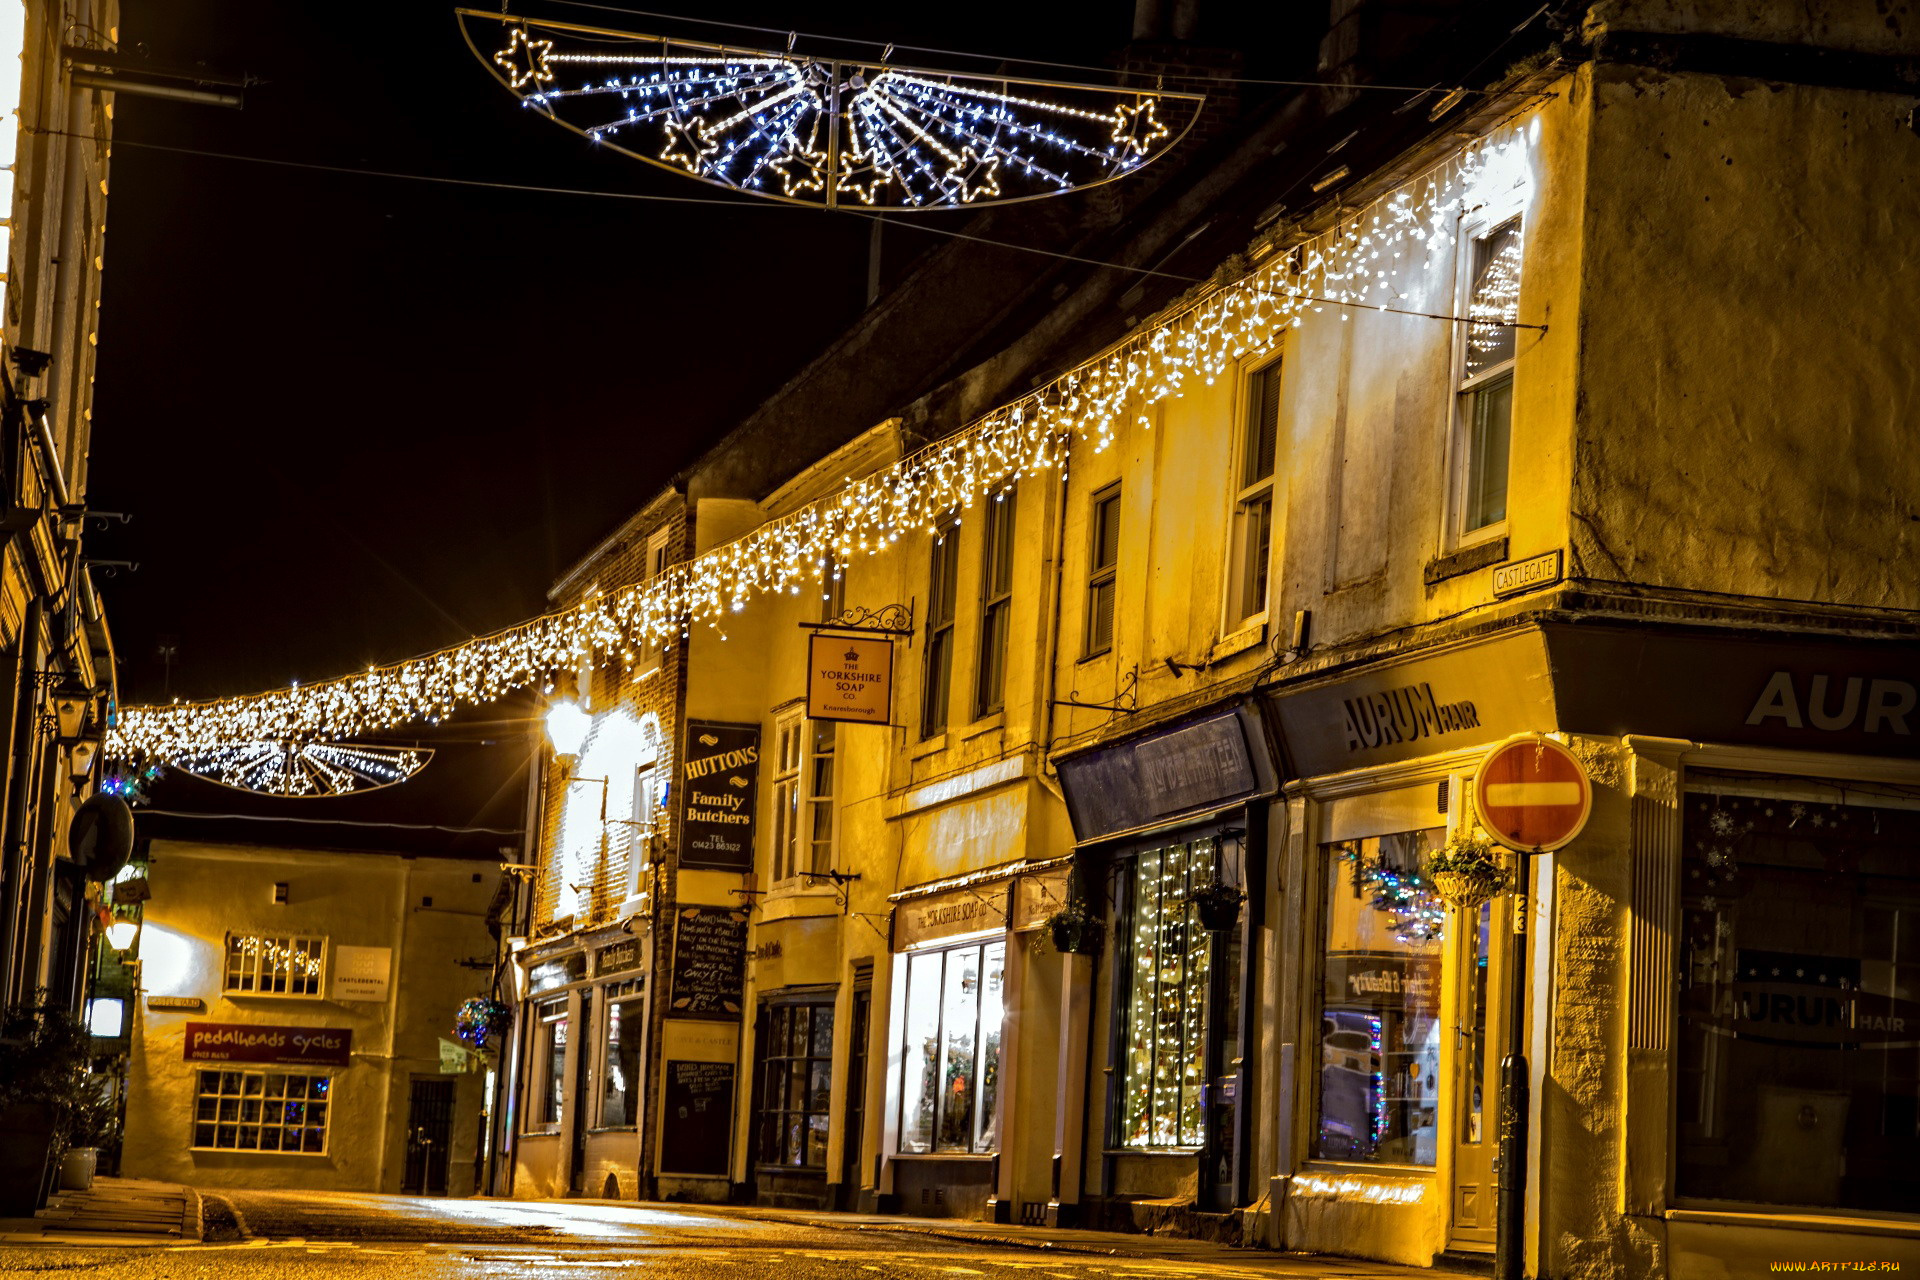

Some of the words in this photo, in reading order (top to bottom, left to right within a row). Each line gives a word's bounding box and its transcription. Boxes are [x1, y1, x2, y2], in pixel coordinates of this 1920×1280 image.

[1497, 557, 1553, 589] CASTLEGATE
[821, 671, 881, 682] YORKSHIRE
[836, 682, 865, 692] SOAP
[823, 704, 876, 715] Knaresborough
[1745, 671, 1918, 735] AUR
[1343, 682, 1444, 751] AURUM
[1438, 700, 1481, 732] HAIR
[685, 746, 758, 780] HUTTONS
[692, 791, 745, 811] Family
[686, 808, 750, 825] Butchers
[692, 841, 714, 850] 01423
[710, 834, 725, 843] TEL
[927, 905, 960, 927] YORKSHIRE
[961, 902, 978, 921] SOAP
[338, 976, 384, 985] CASTLEDENTAL
[684, 969, 709, 980] ONLY
[694, 993, 718, 1002] ONLY
[1859, 1016, 1905, 1033] HAIR
[194, 1030, 285, 1049] pedalheads
[292, 1034, 341, 1054] cycles
